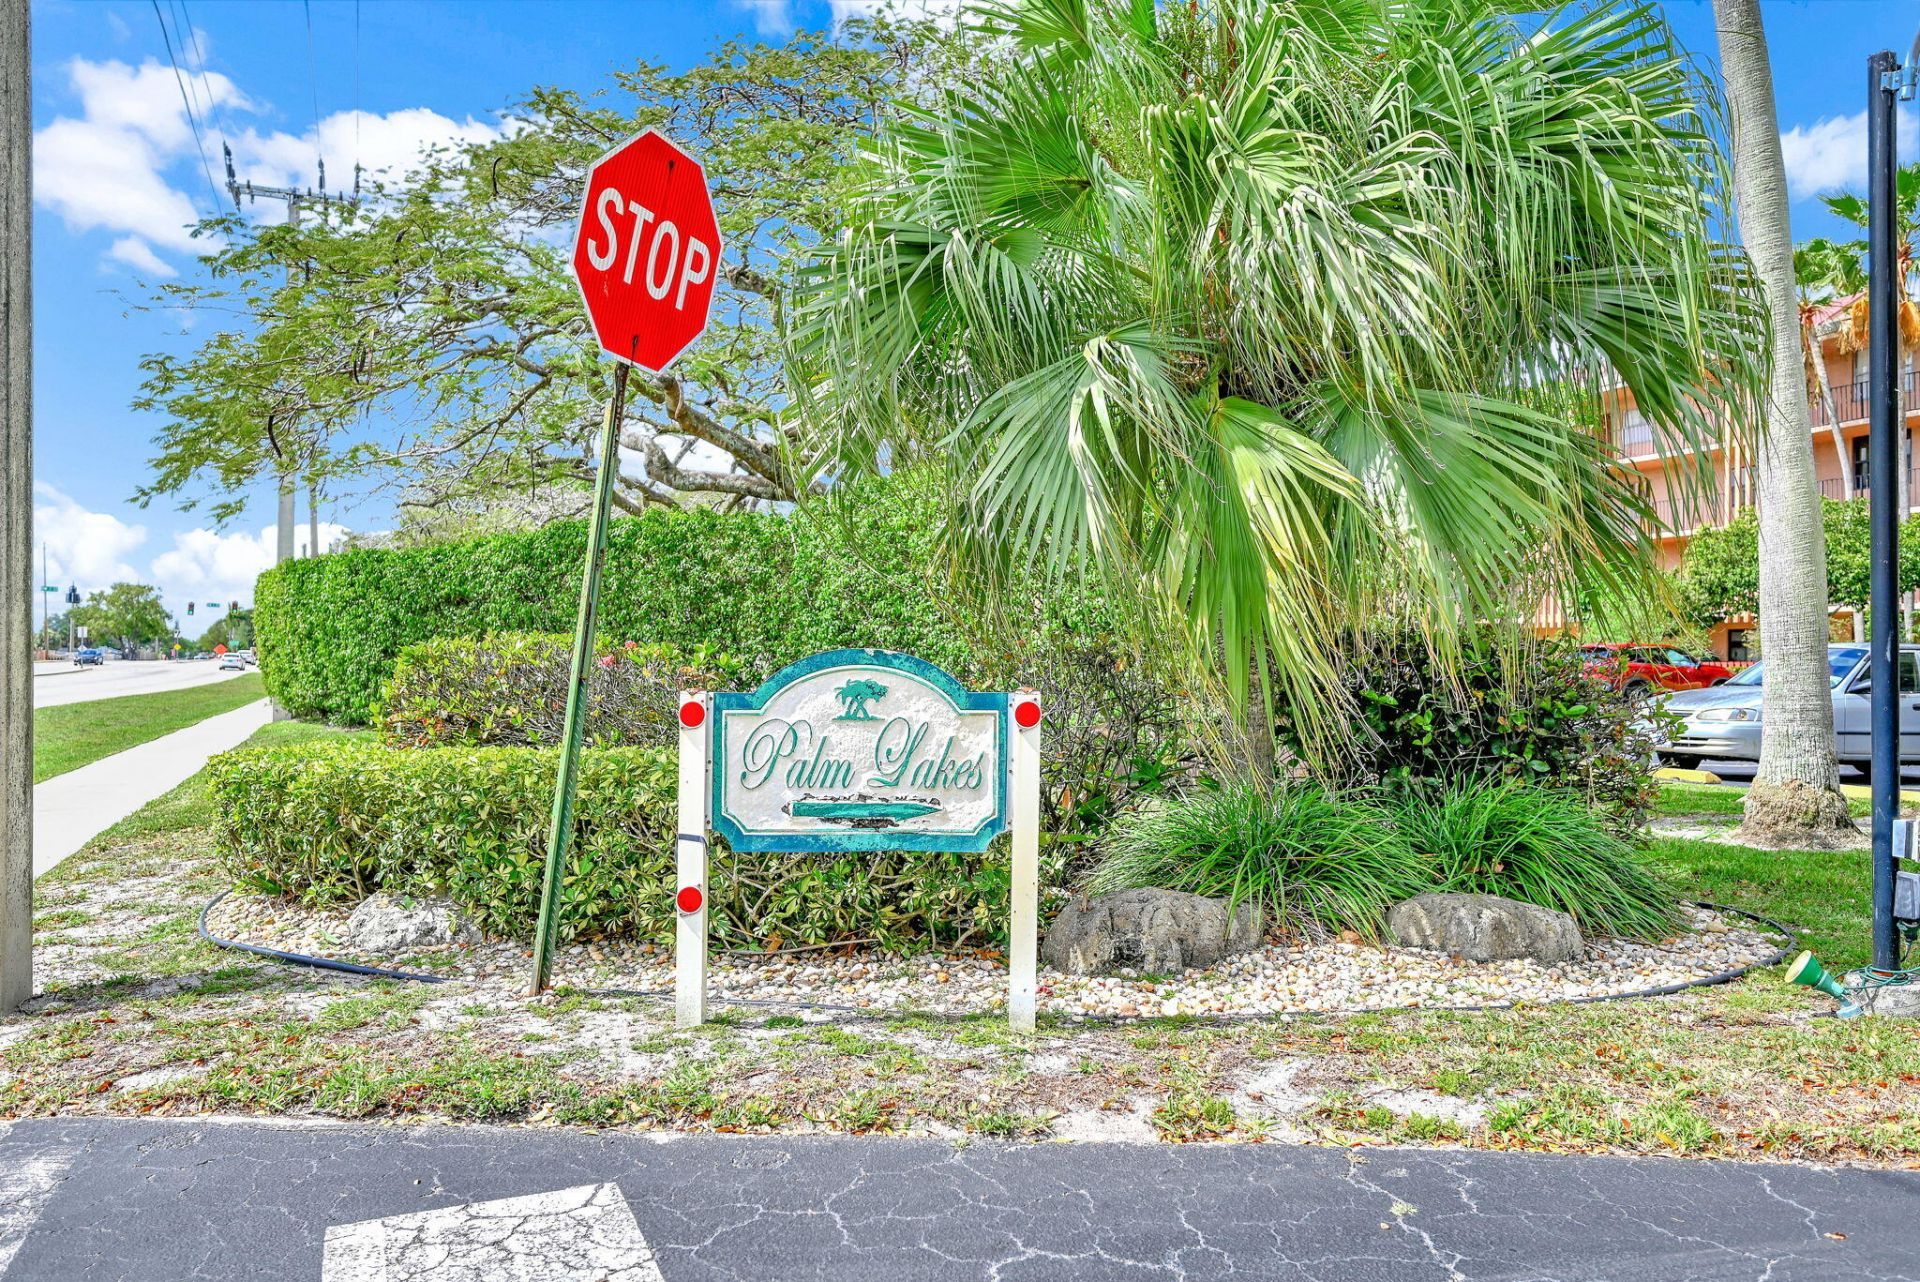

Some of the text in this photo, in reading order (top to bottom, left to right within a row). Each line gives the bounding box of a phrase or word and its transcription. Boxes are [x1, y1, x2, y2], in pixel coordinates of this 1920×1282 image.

[587, 187, 710, 311] STOP
[740, 717, 984, 790] Palm Lakes
